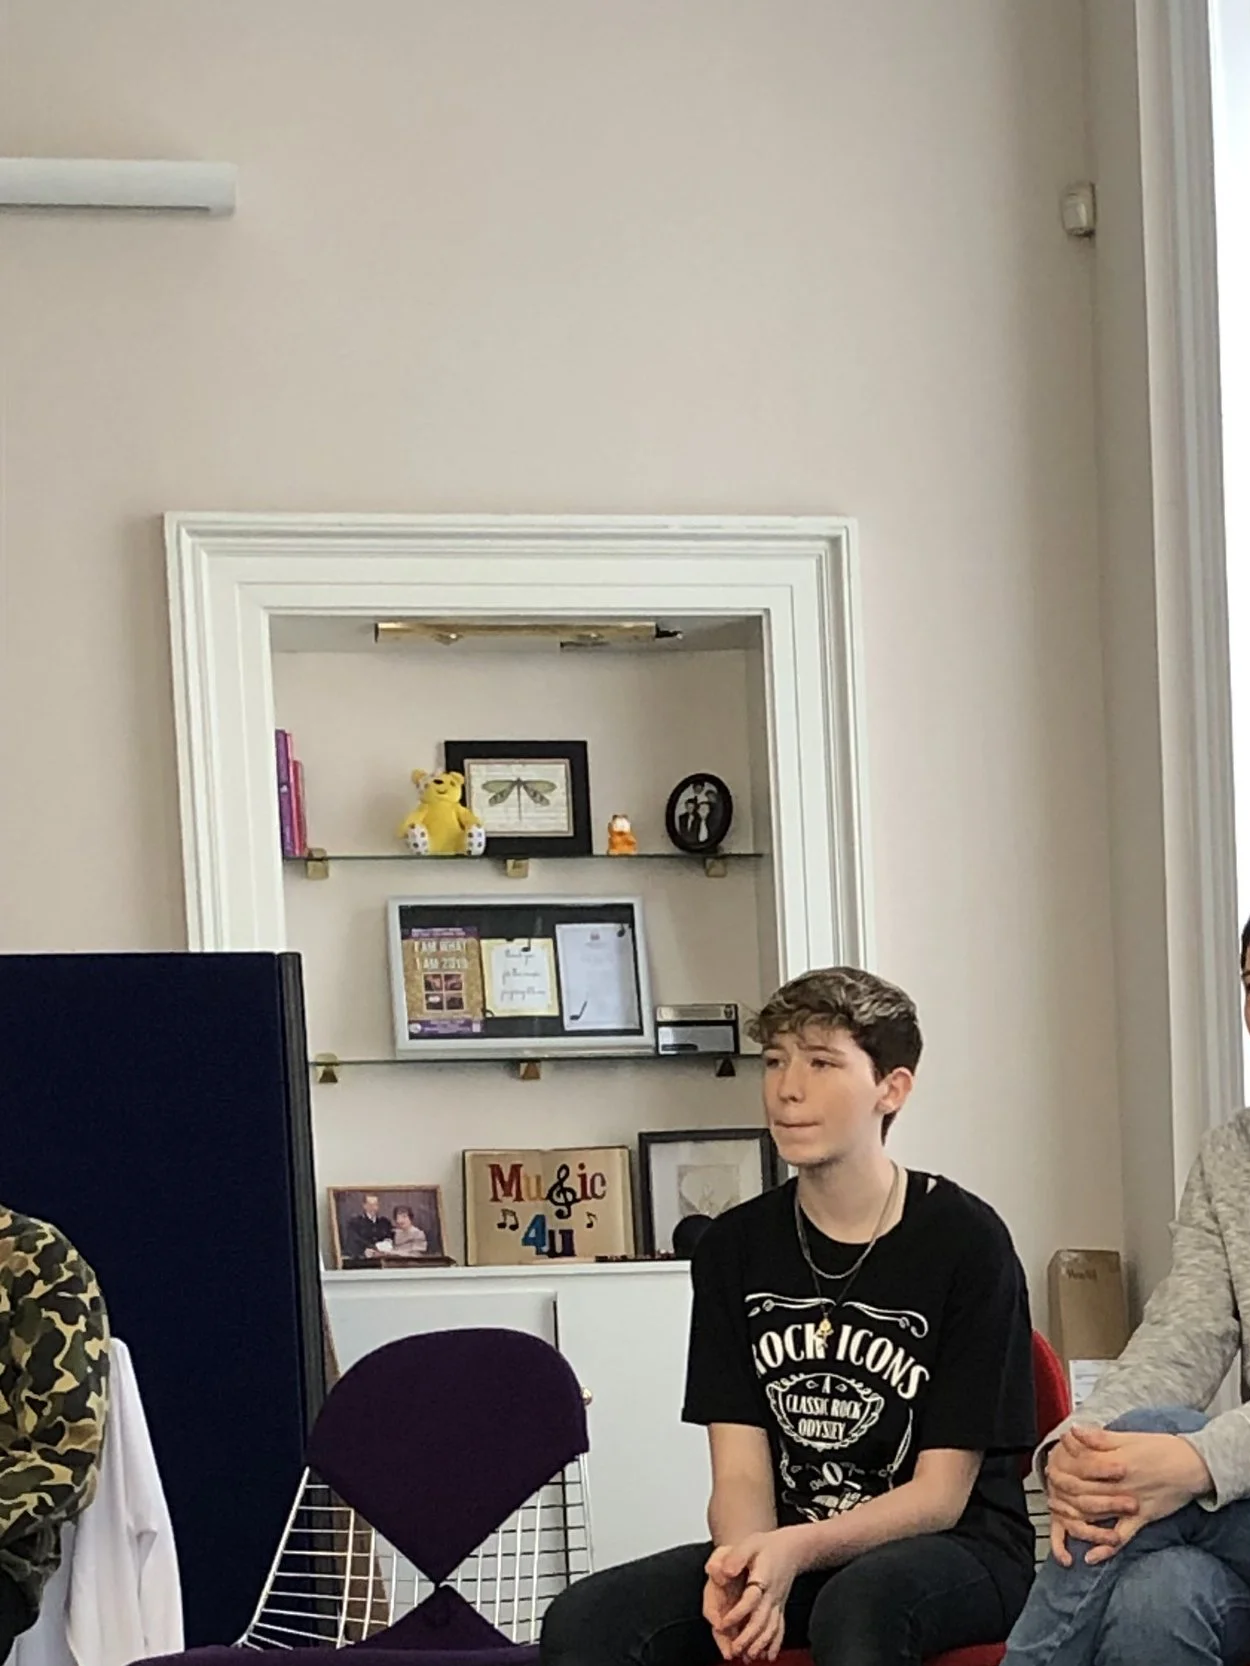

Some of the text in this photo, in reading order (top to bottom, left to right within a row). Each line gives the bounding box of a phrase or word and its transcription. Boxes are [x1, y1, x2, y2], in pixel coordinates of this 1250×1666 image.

[836, 1324, 930, 1400] ICONS
[821, 1375, 831, 1394] A
[785, 1393, 863, 1420] CLASSIC ROCK
